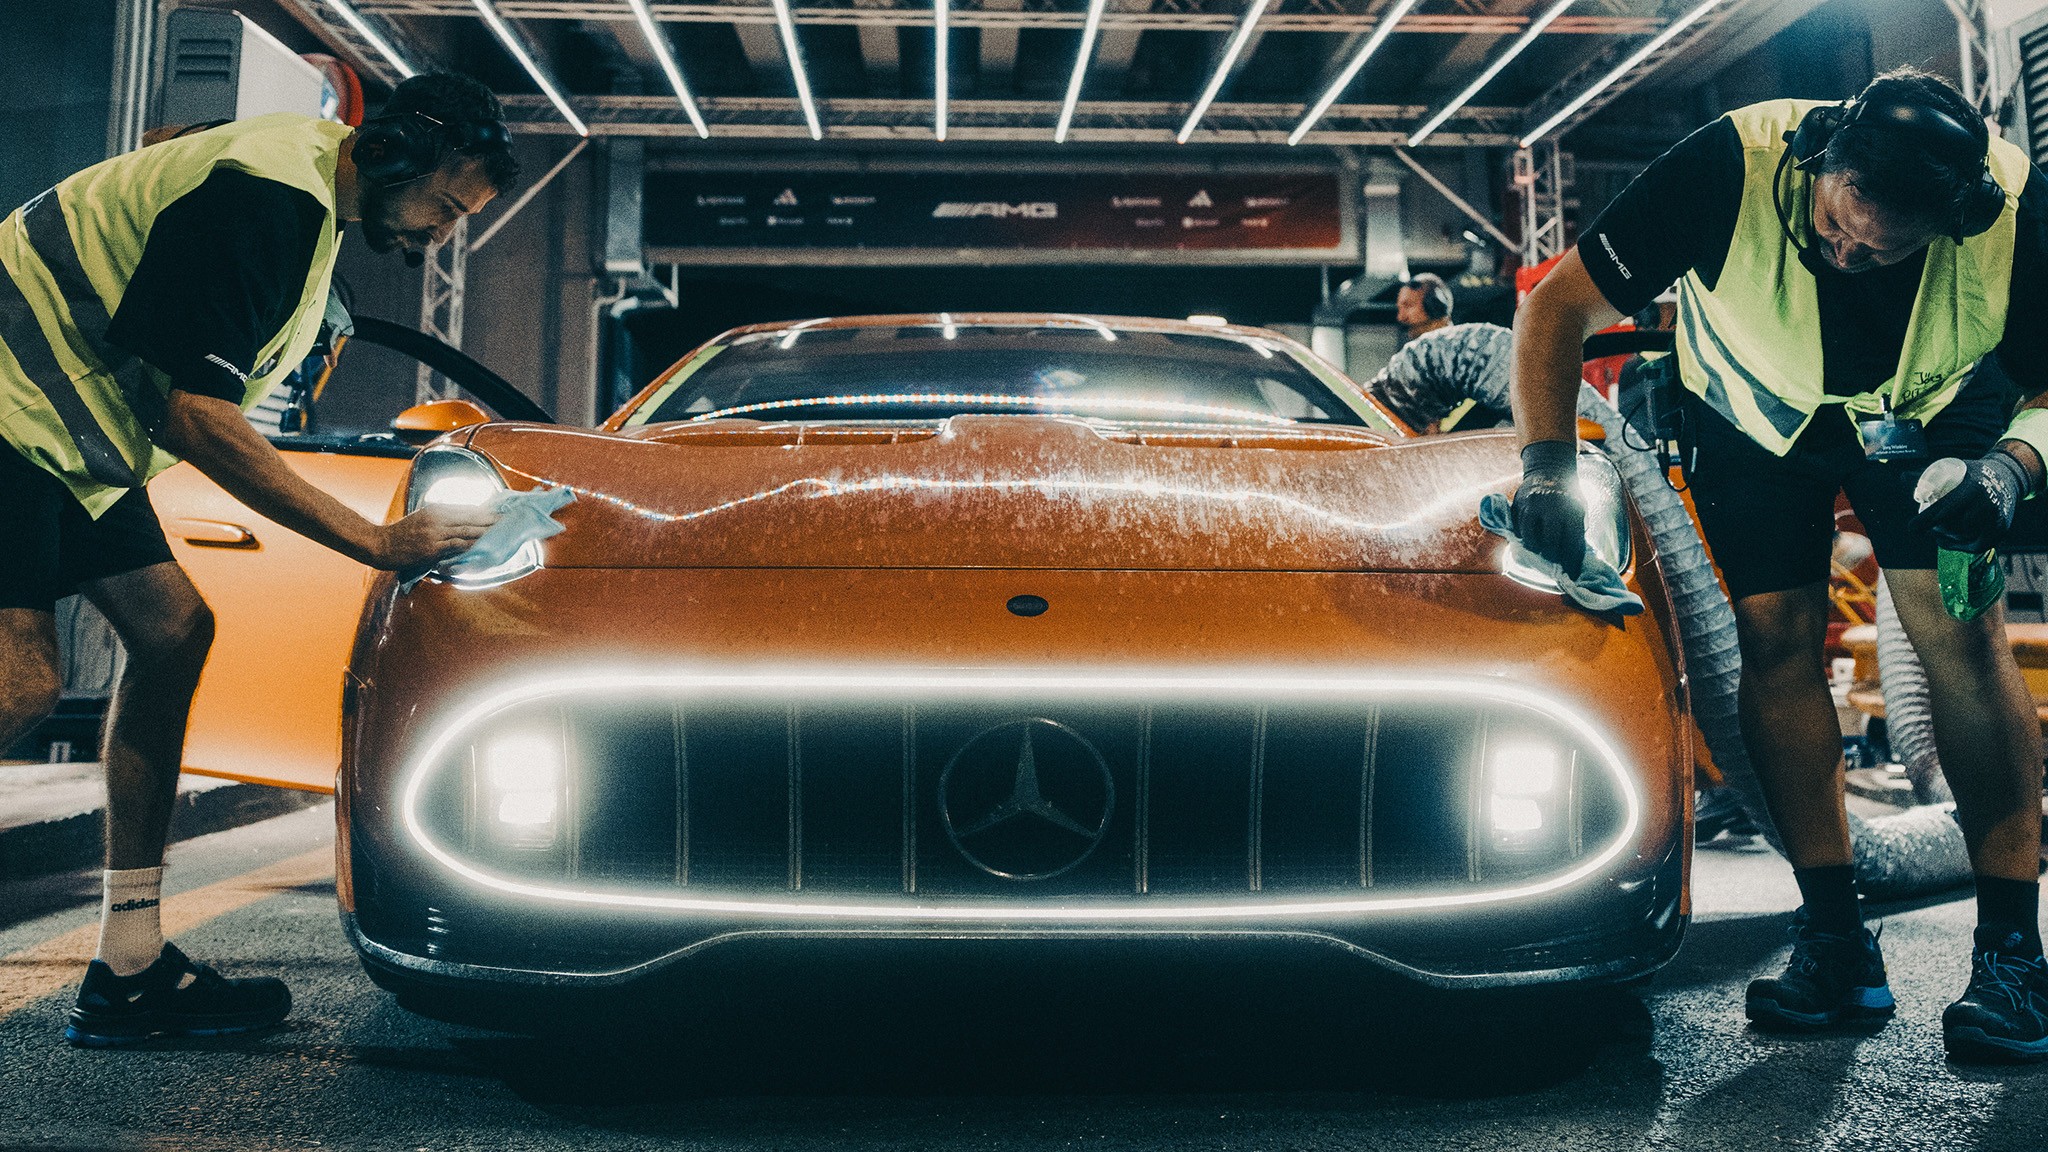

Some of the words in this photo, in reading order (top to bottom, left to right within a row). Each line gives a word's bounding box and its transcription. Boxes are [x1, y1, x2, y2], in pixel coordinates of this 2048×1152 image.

[972, 201, 1058, 218] AMG
[1605, 247, 1632, 280] AMG
[111, 897, 160, 912] adidas
